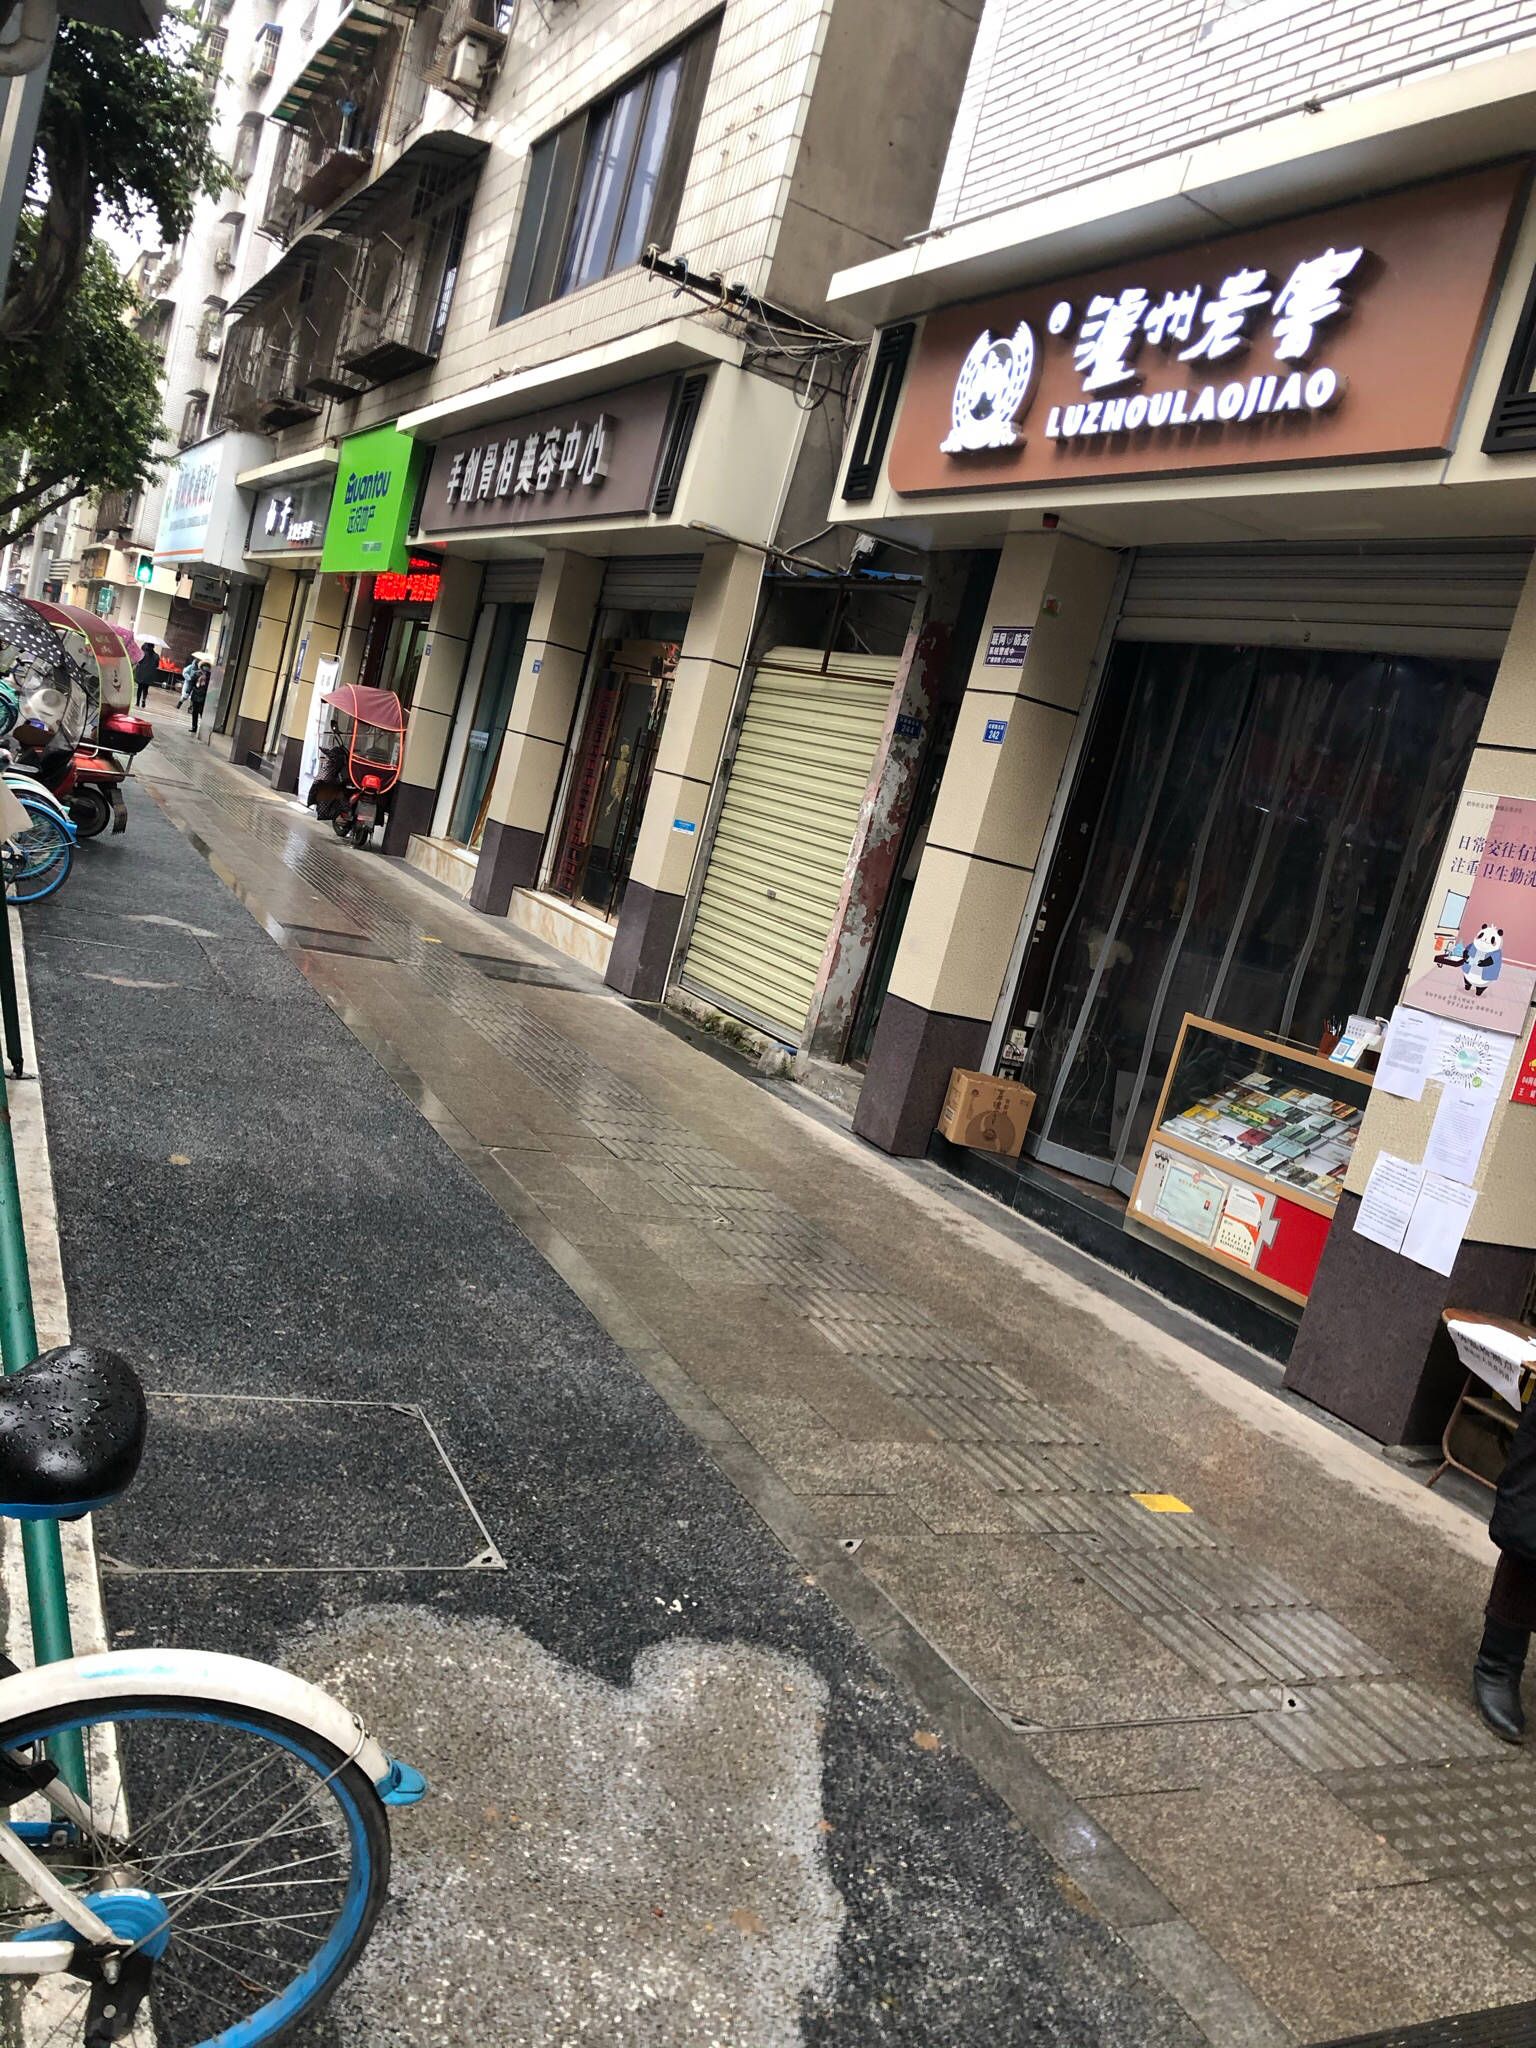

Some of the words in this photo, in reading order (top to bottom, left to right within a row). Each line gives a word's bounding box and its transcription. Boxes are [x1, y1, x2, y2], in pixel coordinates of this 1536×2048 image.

[1045, 367, 1337, 439] LUZHOULAOJIAO
[991, 632, 1008, 646] 联网
[1013, 632, 1031, 647] 防盗
[987, 729, 1000, 740] 242
[1458, 834, 1536, 864] 日常交往有
